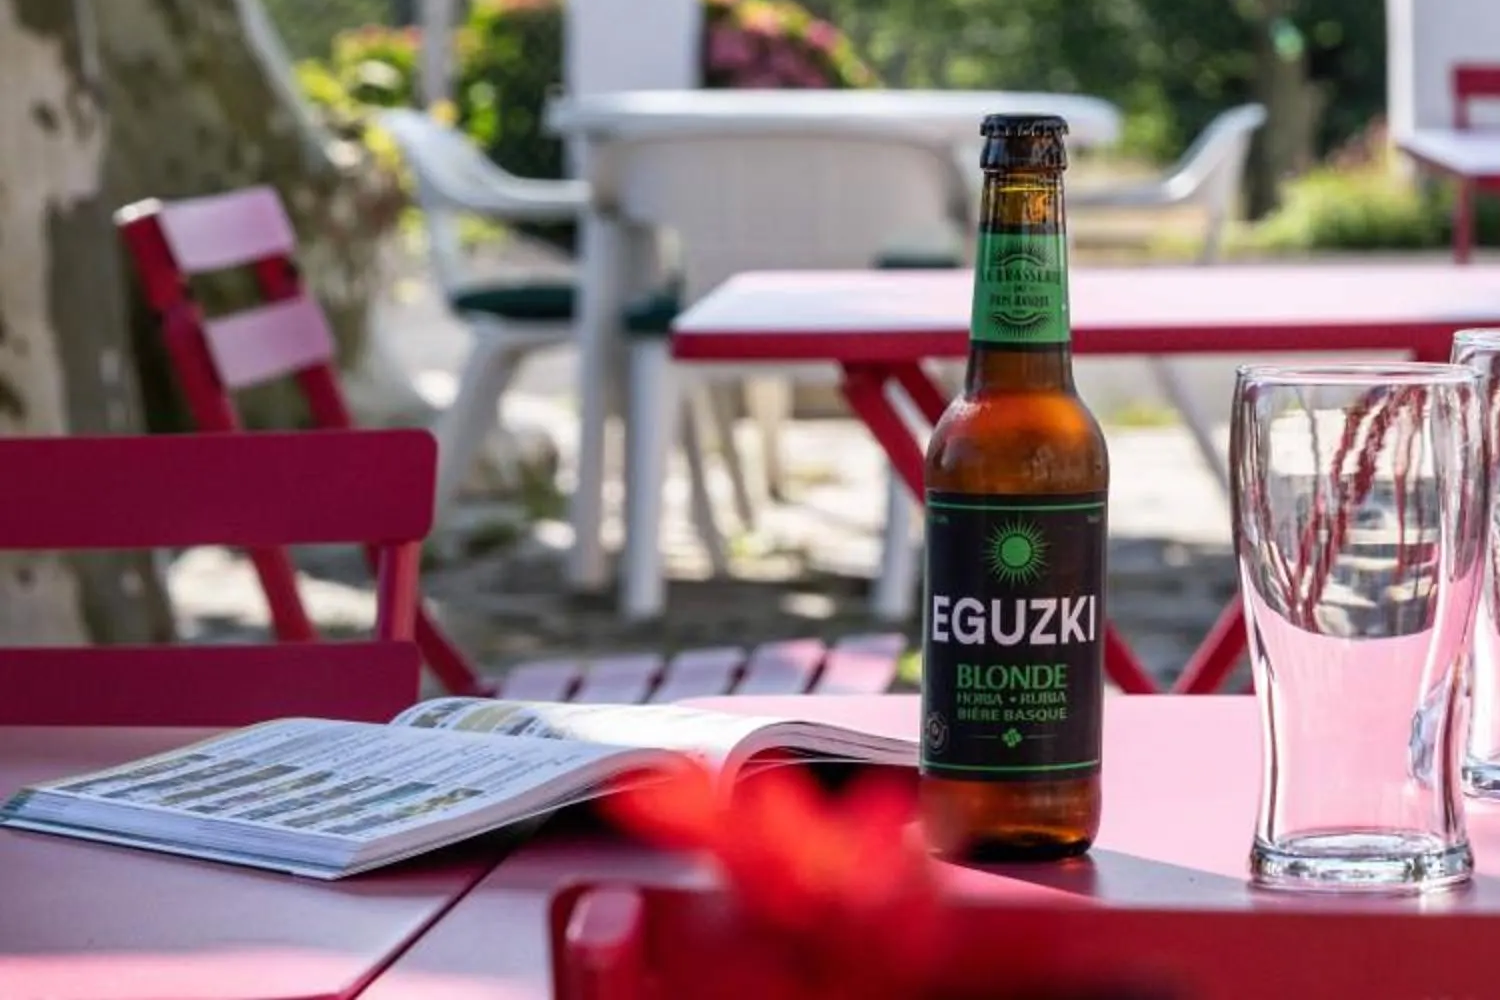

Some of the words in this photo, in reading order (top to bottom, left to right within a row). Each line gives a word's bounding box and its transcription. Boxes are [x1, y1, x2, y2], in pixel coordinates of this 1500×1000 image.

[932, 595, 1096, 646] EGUZKI
[956, 663, 1069, 690] BLONDE
[1003, 707, 1069, 722] BASQUE
